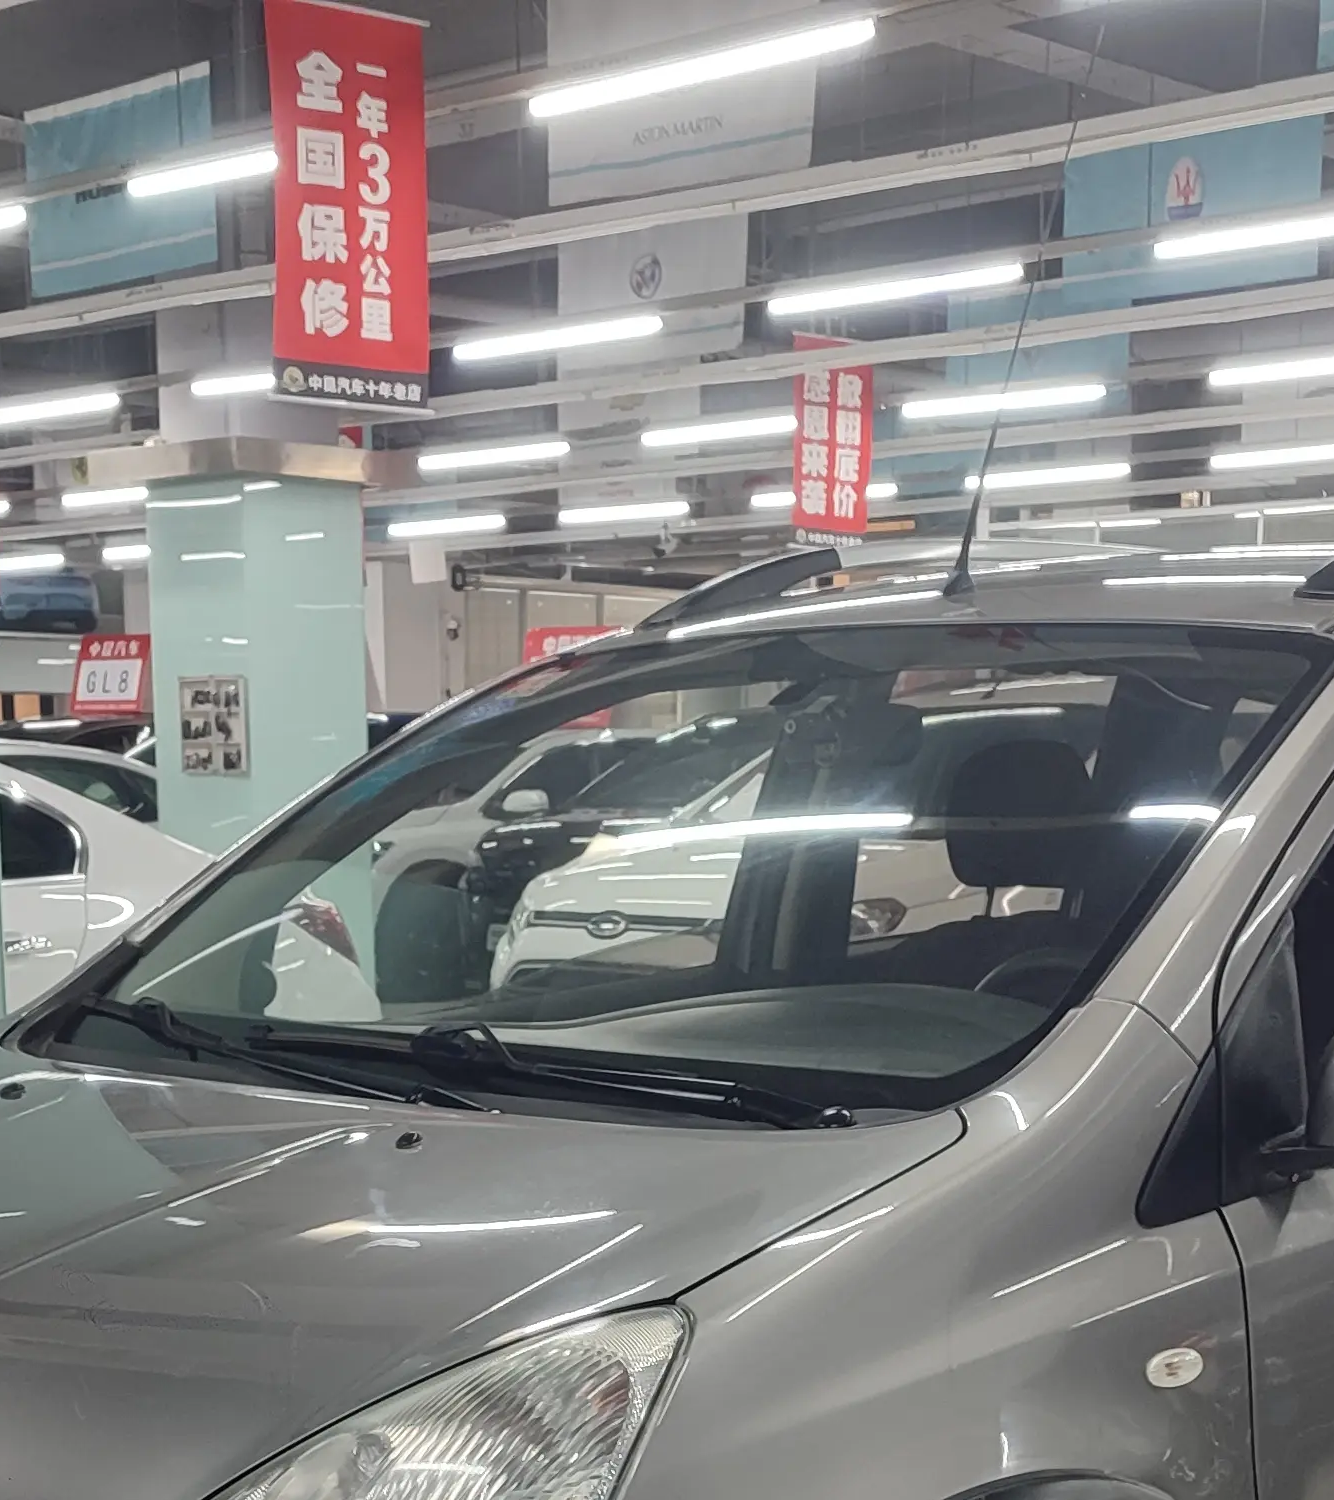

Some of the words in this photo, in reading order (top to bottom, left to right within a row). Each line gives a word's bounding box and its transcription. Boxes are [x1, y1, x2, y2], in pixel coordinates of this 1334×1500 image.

[295, 49, 350, 338] 全国保修
[355, 61, 394, 342] 一年3万公里
[86, 669, 129, 694] GL8
